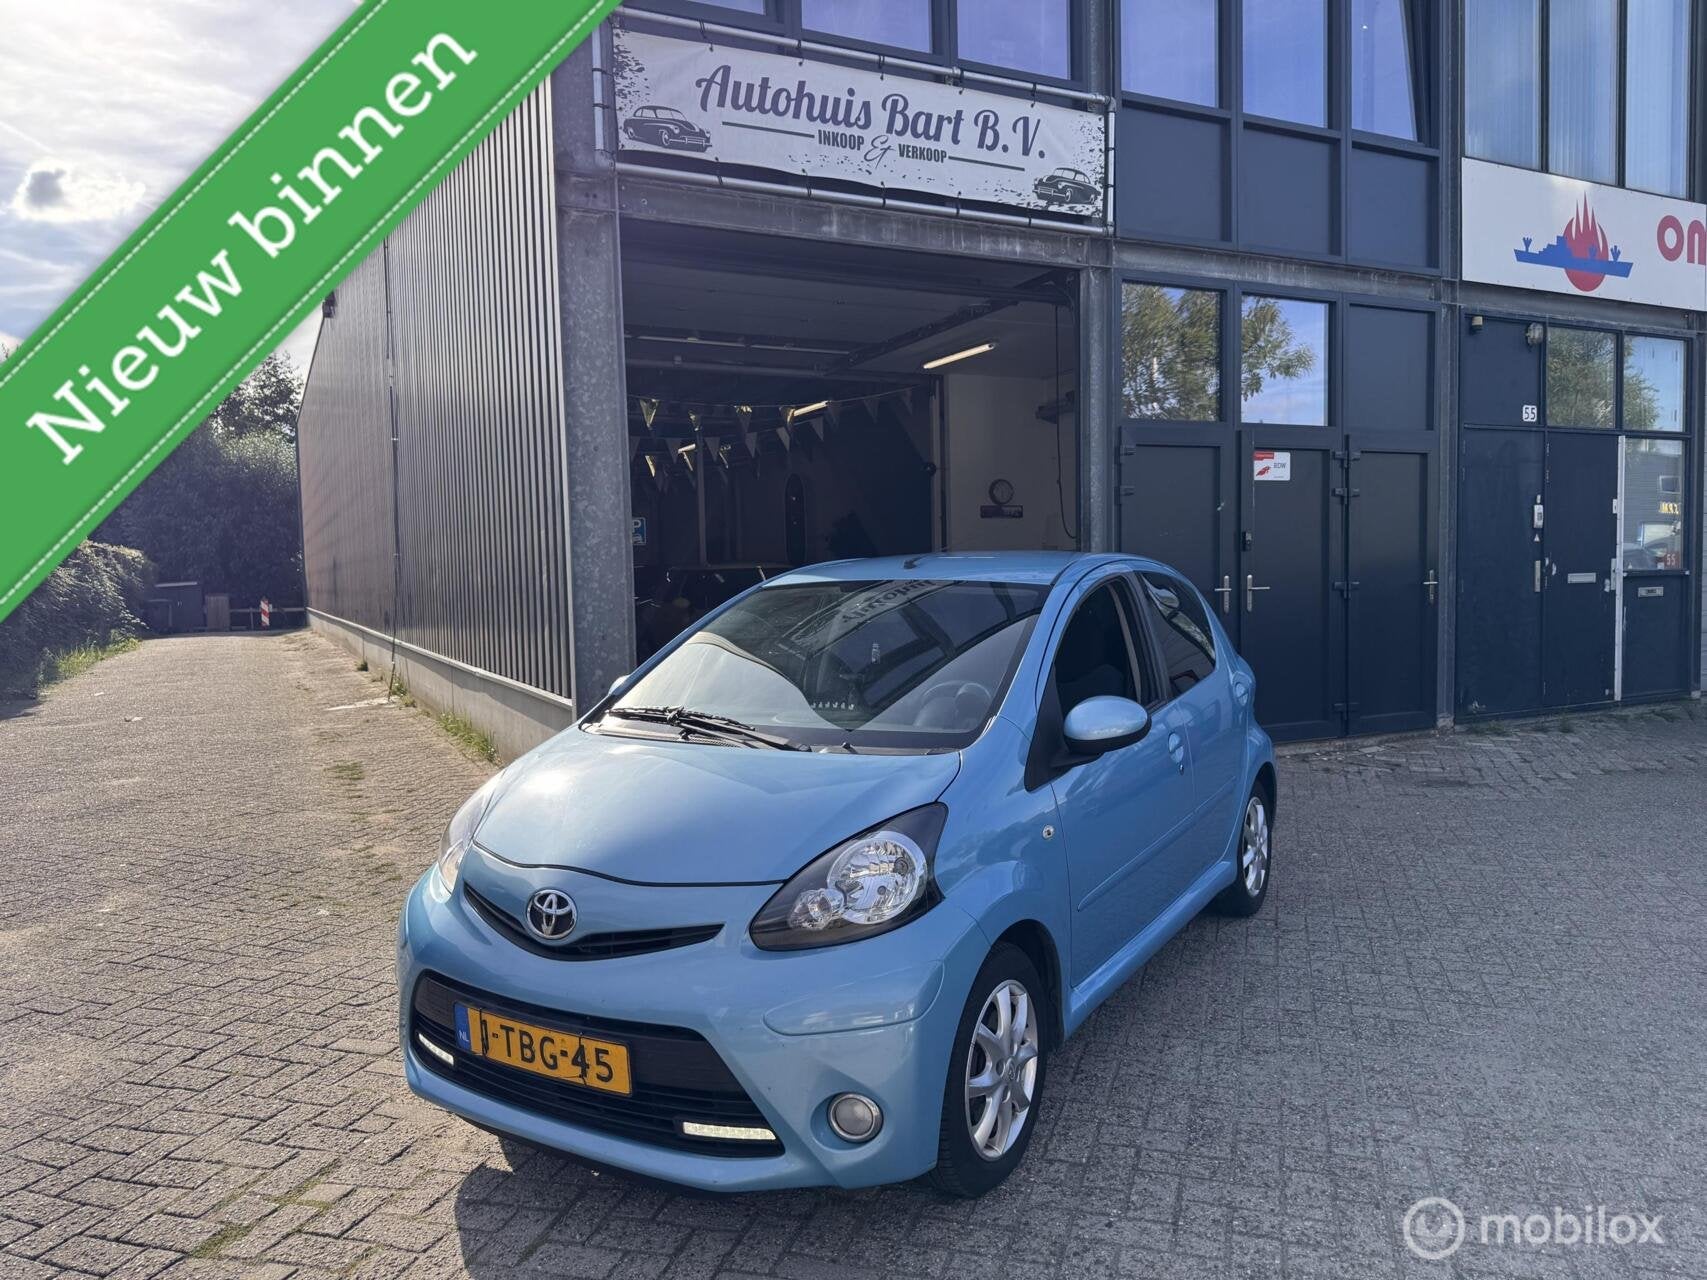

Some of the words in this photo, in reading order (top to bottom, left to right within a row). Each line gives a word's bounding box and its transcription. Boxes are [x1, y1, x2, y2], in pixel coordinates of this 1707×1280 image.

[695, 64, 872, 130] Autohuis
[881, 93, 964, 145] Bart
[973, 109, 1046, 159] B.V.
[817, 129, 865, 151] INKOOP
[898, 143, 948, 163] VERKOOP
[1523, 406, 1537, 421] 55
[458, 1029, 470, 1043] NL
